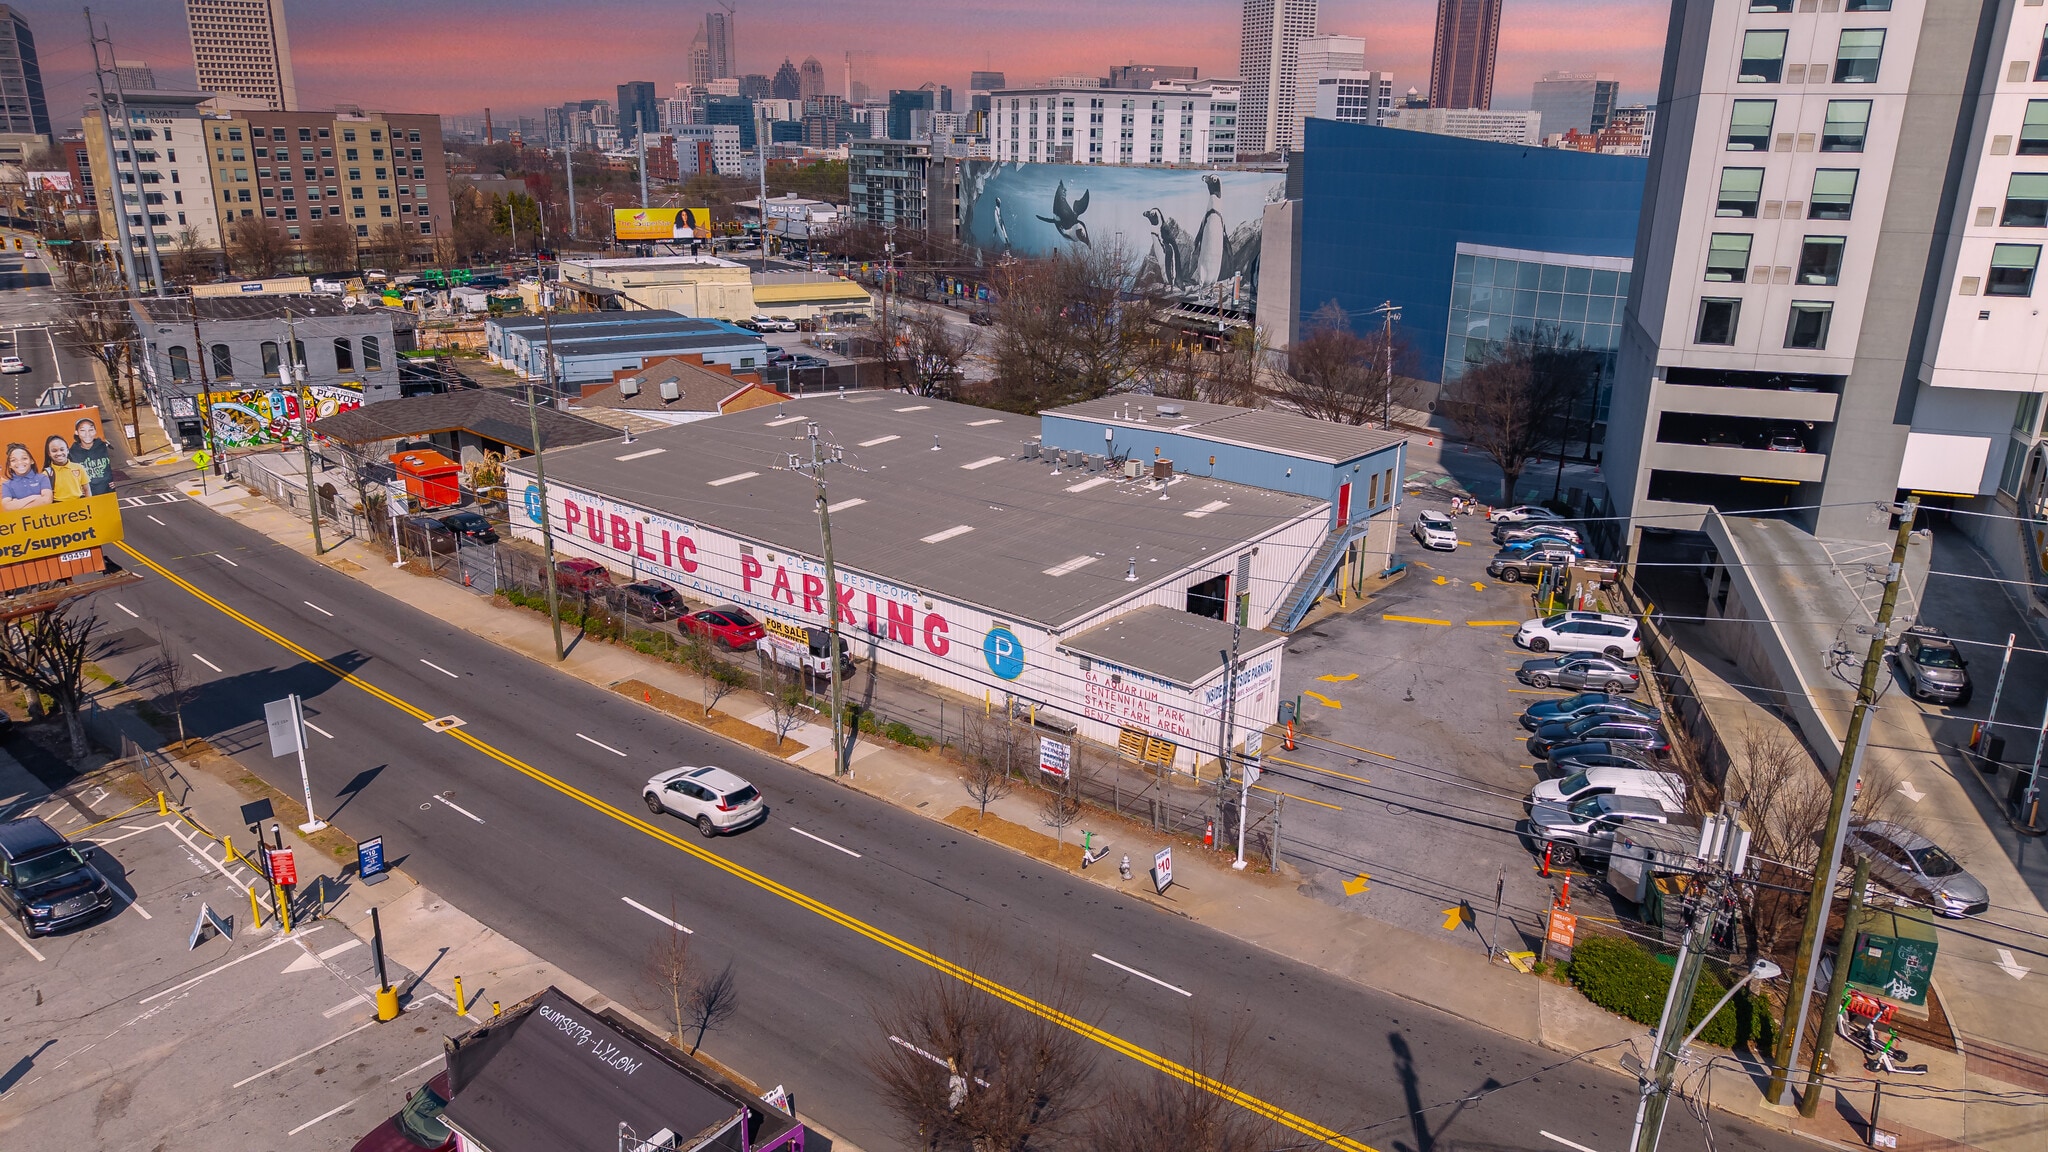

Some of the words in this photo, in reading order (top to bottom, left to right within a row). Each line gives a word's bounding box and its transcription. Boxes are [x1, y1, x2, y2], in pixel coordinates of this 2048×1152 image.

[149, 110, 180, 118] HYATT
[21, 504, 93, 532] Futures!
[651, 517, 690, 534] PARKING
[62, 550, 90, 562] 49497
[564, 498, 698, 574] PUBLIC
[741, 553, 950, 657] PARKING
[638, 561, 684, 584] INSIDE
[732, 593, 801, 624] OUTSIDE
[787, 556, 827, 576] CLEAN
[843, 573, 918, 604] RESTROOMS
[766, 617, 782, 632] FOR
[784, 624, 808, 640] SALE
[995, 635, 1013, 666] P
[1085, 671, 1098, 682] GA
[1104, 678, 1158, 702] AQUARIUM
[1098, 660, 1146, 681] PARKING
[1151, 676, 1173, 690] FOR
[1084, 707, 1110, 722] BENZ
[1084, 695, 1117, 713] STATE
[1123, 707, 1151, 724] FARM
[1157, 719, 1191, 738] ARENA
[1085, 683, 1151, 713] CENTENNIAL
[1157, 705, 1185, 723] PARK
[1158, 857, 1170, 873] $10
